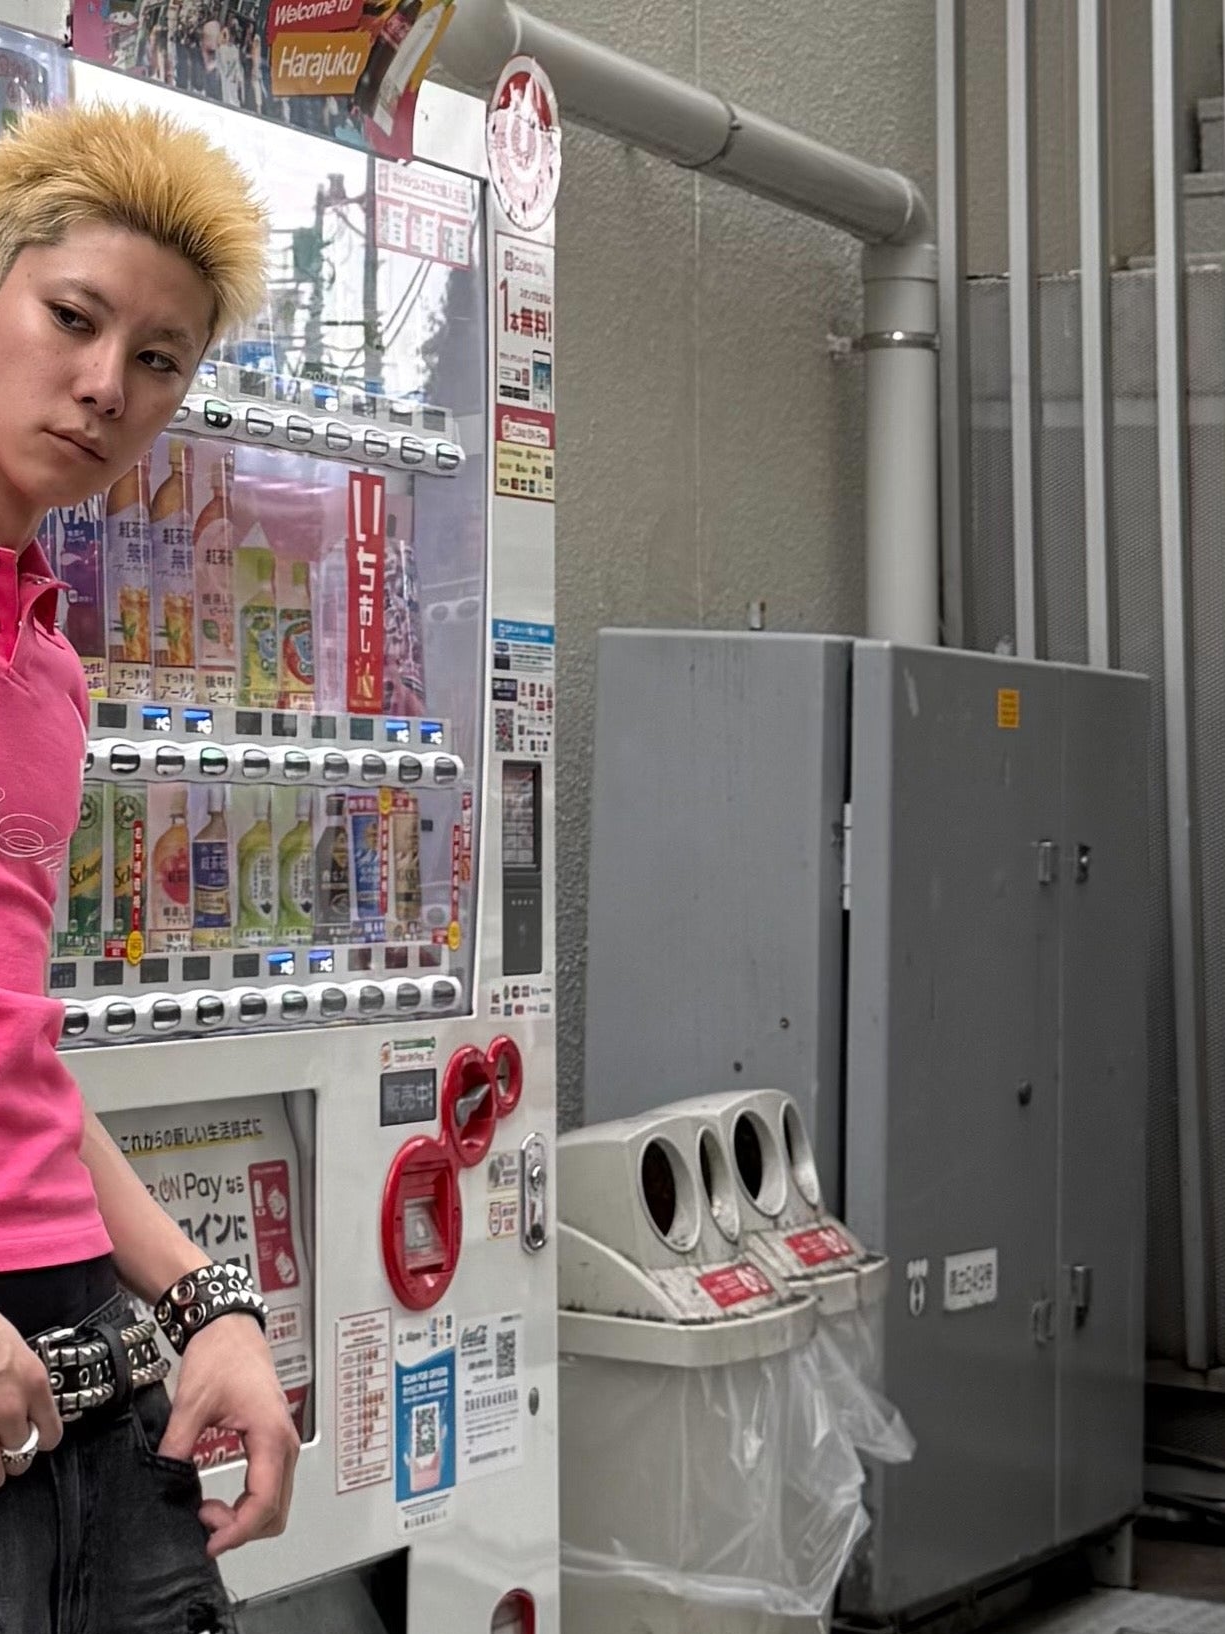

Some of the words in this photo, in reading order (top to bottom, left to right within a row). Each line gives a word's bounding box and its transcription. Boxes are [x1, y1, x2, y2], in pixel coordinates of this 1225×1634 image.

[274, 0, 335, 27] Welcome
[278, 45, 362, 85] Harajuku
[184, 1172, 222, 1204] Pay
[226, 1176, 246, 1195] なら
